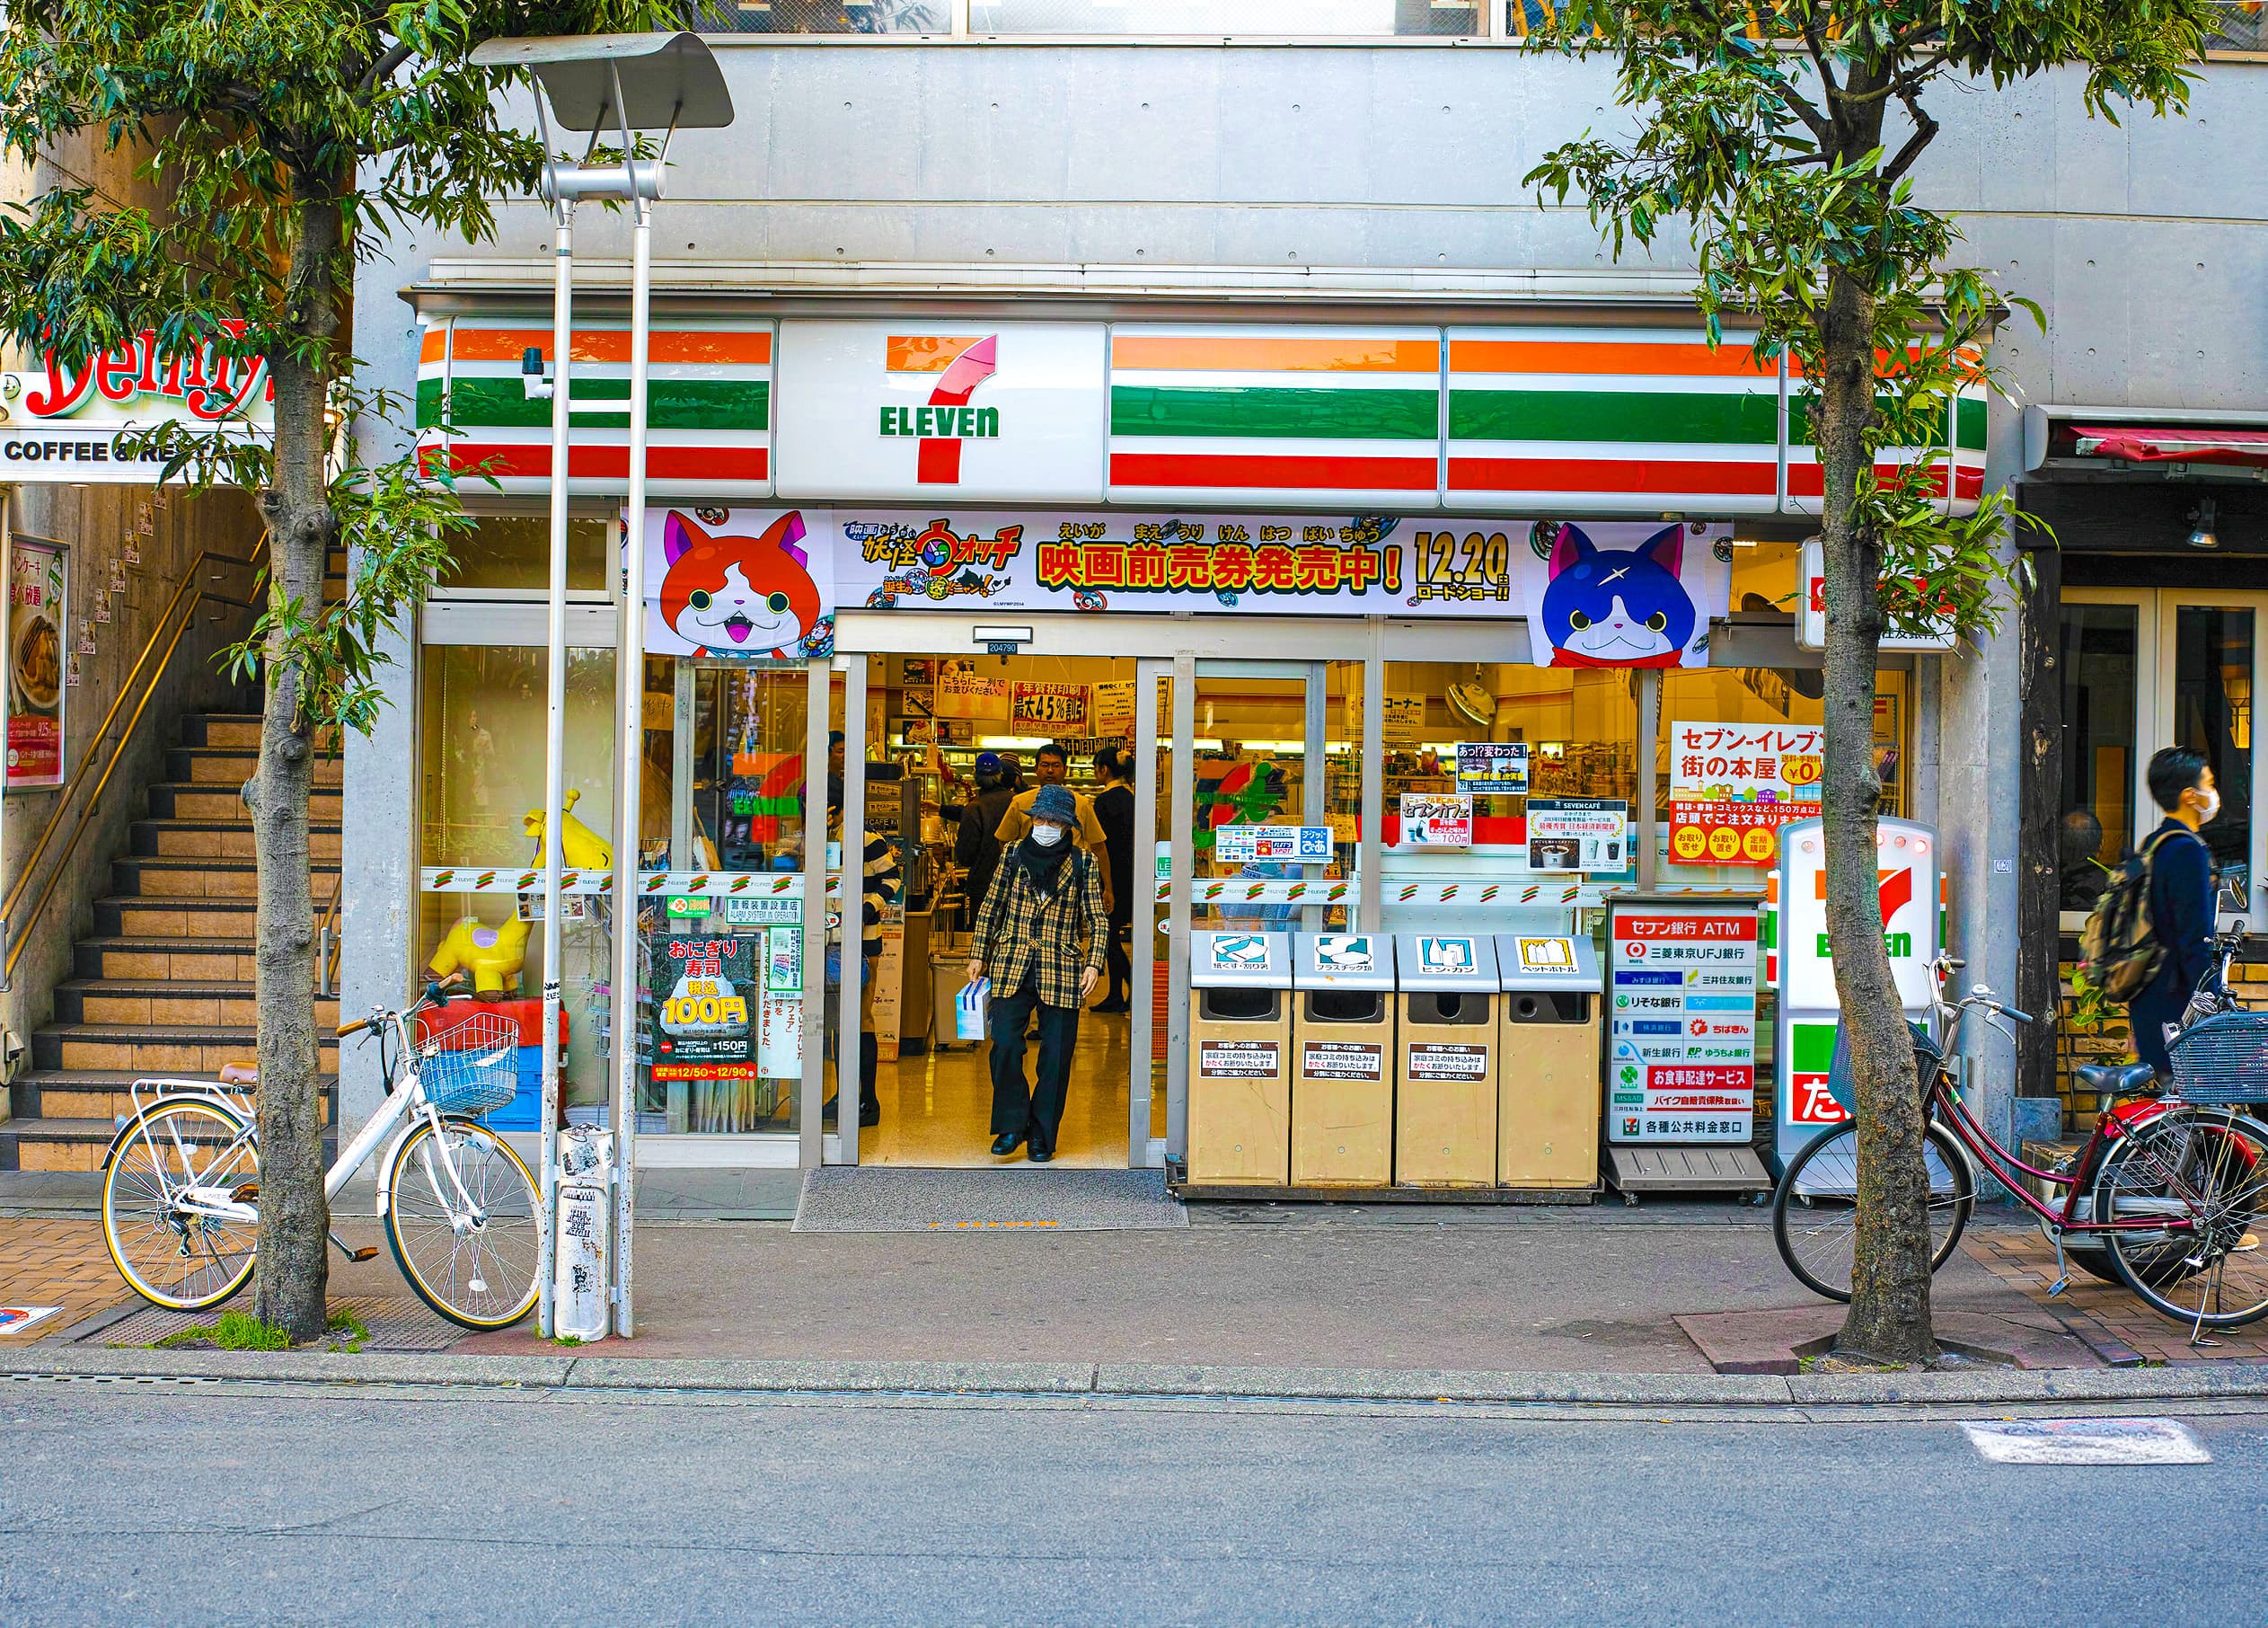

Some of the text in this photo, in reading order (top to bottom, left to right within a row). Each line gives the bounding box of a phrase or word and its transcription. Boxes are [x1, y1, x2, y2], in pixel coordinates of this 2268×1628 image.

[4, 441, 109, 461] COFFEE
[1059, 522, 1106, 538] えいが
[1134, 524, 1161, 539] まえ
[1178, 525, 1204, 540] うり
[1219, 525, 1249, 541] けん
[1260, 525, 1292, 541] はつ
[1302, 526, 1335, 541] ばい
[1338, 526, 1380, 544] ちゅう
[1415, 532, 1509, 586] 12.20
[989, 643, 1017, 652] 204790
[1681, 755, 1777, 779] 街の本屋
[1403, 802, 1469, 818] セブンカフェ
[1443, 835, 1468, 843] 100円
[1678, 834, 1702, 843] お取り
[1712, 835, 1736, 844] お取り
[1681, 842, 1699, 852] 寄せ
[1716, 843, 1733, 853] 置き
[730, 911, 746, 919] ALARM
[747, 911, 766, 919] SYSTEM
[1631, 921, 1740, 935] セブン銀行 ATM
[668, 940, 737, 959] おにぎり
[1651, 948, 1744, 960] 三菱東京UFJ銀行
[685, 959, 721, 977] 寿司
[687, 980, 719, 995] 税込
[1702, 976, 1752, 985] 三井住友銀行
[1631, 997, 1681, 1008] りそな銀行
[663, 996, 749, 1025] 100円
[718, 1040, 747, 1051] 150円
[1643, 1048, 1681, 1057] 新生銀行
[1705, 1048, 1751, 1057] ゆうちょ銀行
[1654, 1070, 1746, 1085] お食事配達サービス
[1655, 1095, 1744, 1105] バイク自賠責保険取扱い
[1646, 1120, 1742, 1133] 各種公共料金窓口
